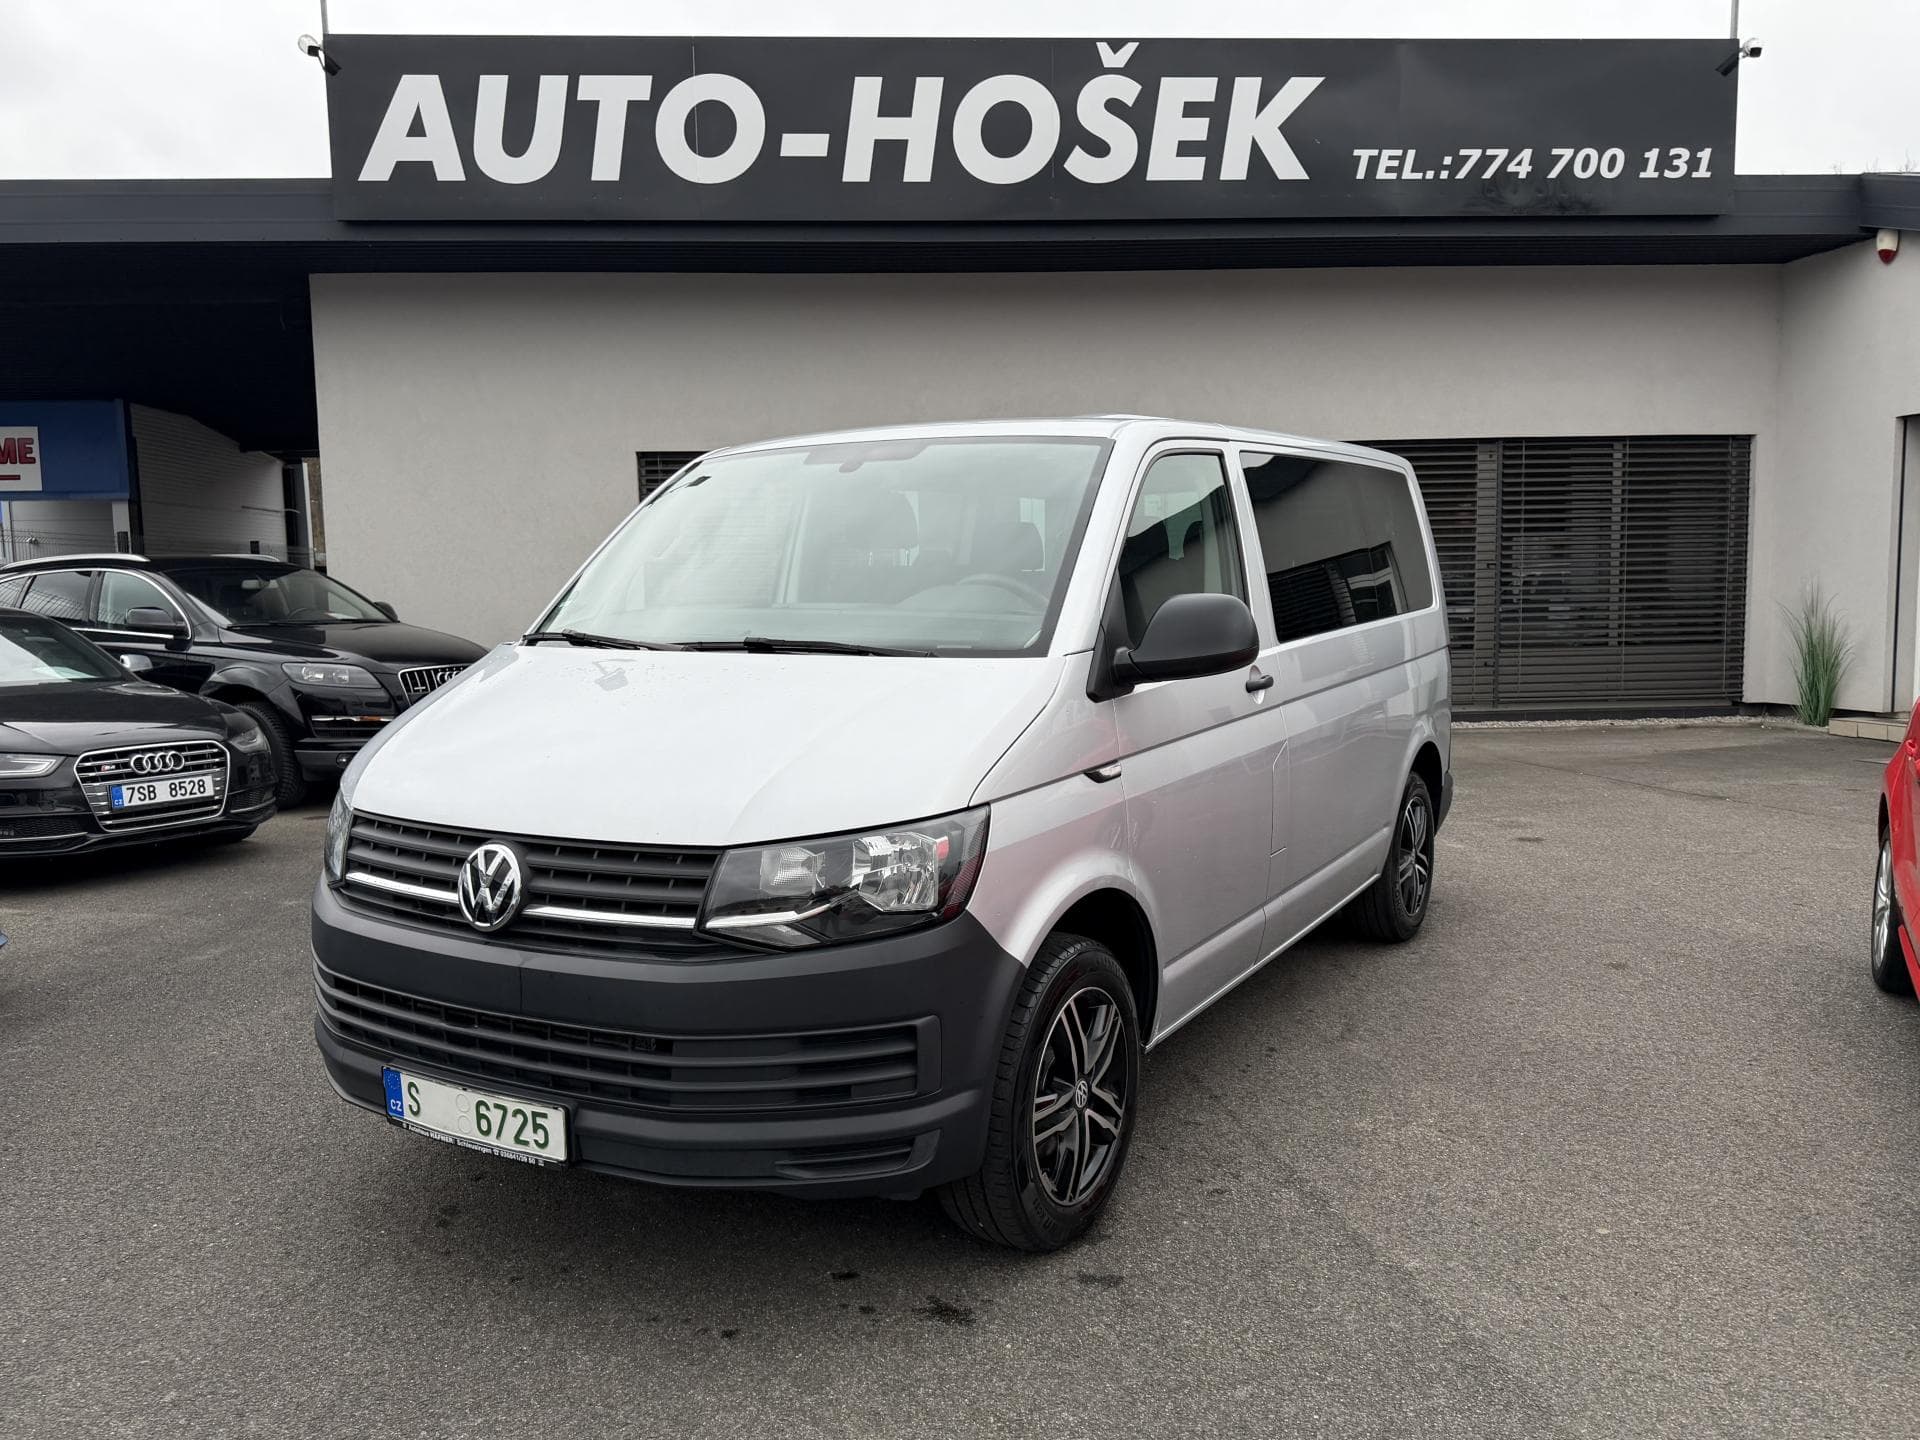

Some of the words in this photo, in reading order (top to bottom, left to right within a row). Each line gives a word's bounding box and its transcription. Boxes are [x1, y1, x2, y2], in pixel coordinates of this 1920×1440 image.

[358, 41, 1326, 184] AUTO-HOŠEK
[1352, 147, 1533, 180] TEL.:774
[1546, 147, 1625, 180] 700
[1639, 147, 1713, 179] 131
[126, 784, 157, 804] 7SB
[169, 779, 206, 798] 8528
[390, 1099, 402, 1112] CZ
[407, 1081, 421, 1116] S
[475, 1099, 549, 1149] 6725
